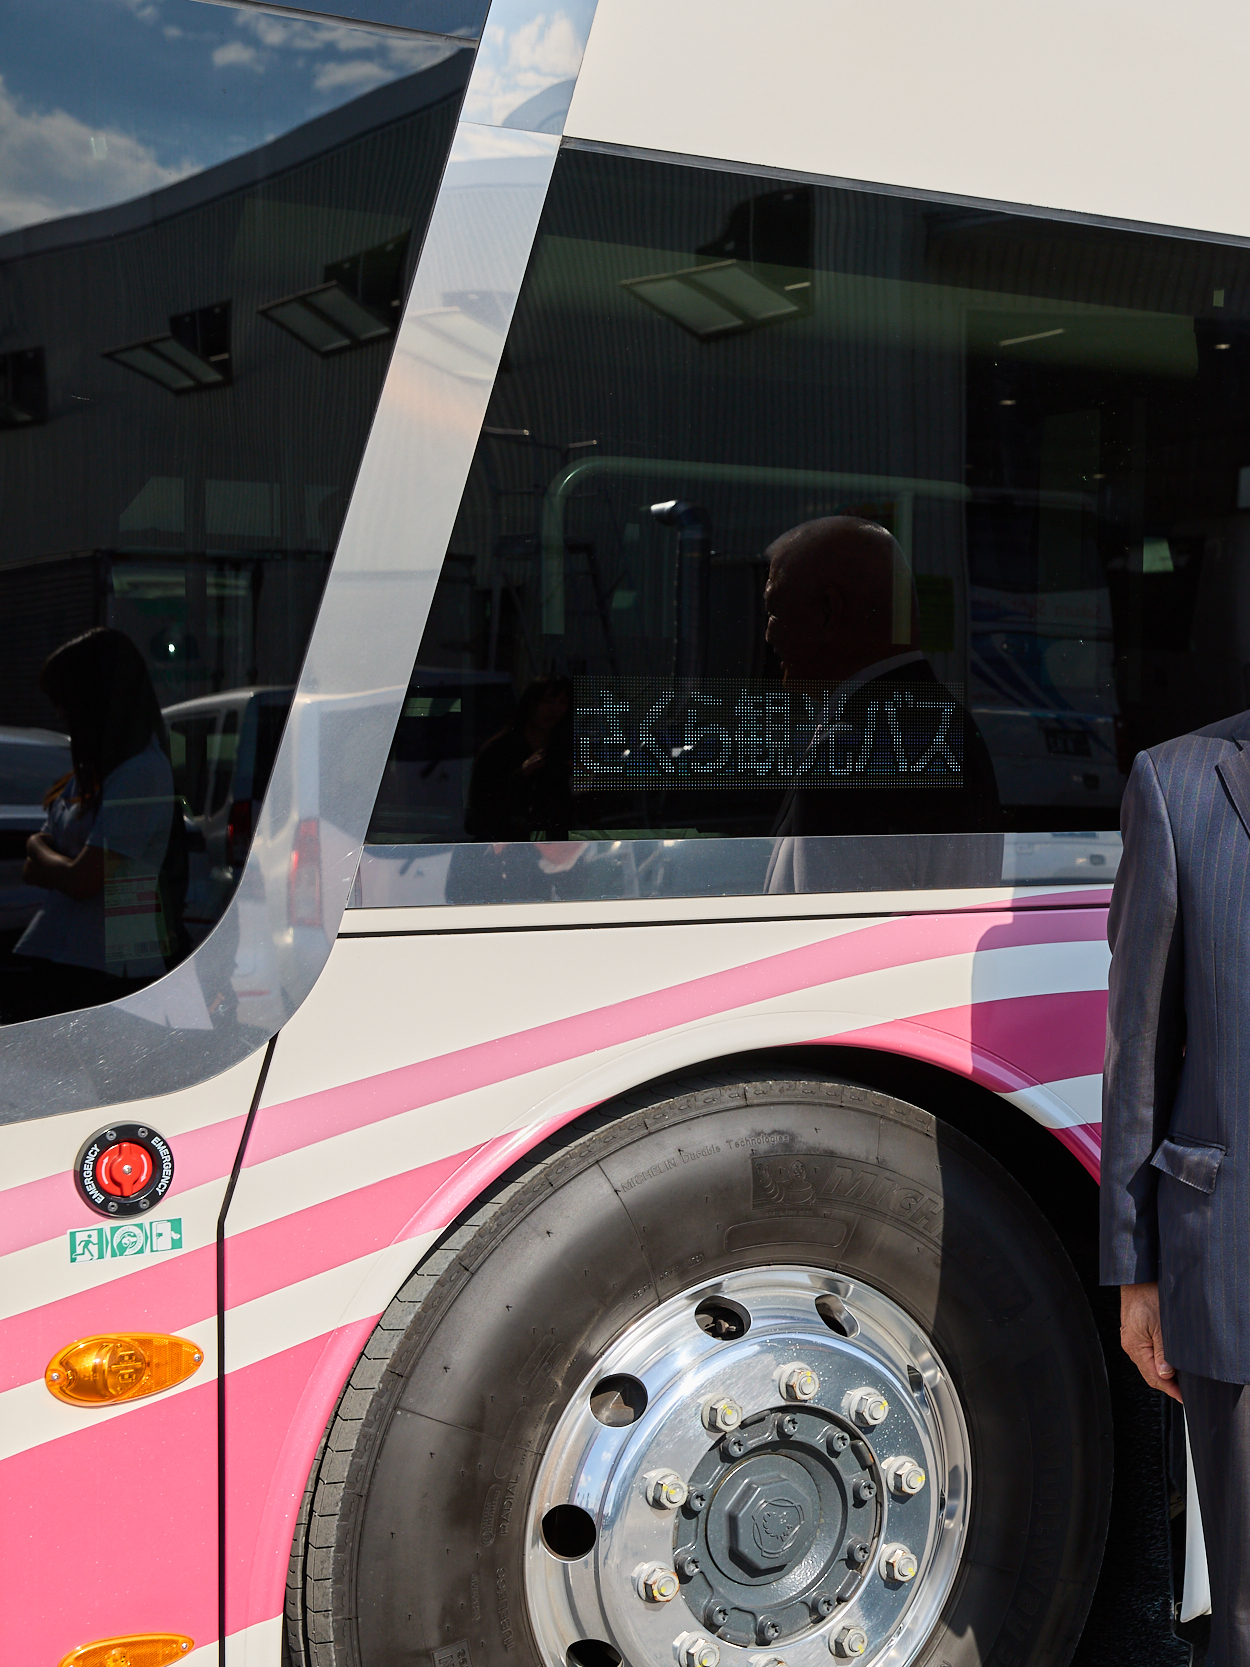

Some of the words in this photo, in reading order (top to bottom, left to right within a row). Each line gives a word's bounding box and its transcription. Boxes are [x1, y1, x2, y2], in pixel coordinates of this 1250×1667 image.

[575, 689, 961, 776] さくら観光バス
[83, 1143, 105, 1204] EMERGENCY
[150, 1136, 172, 1196] EMERGENCY
[621, 1158, 677, 1194] MICHELIN
[725, 1132, 790, 1151] Technologies
[499, 1474, 520, 1536] RADIAL
[496, 1566, 515, 1654] TUBELESS
